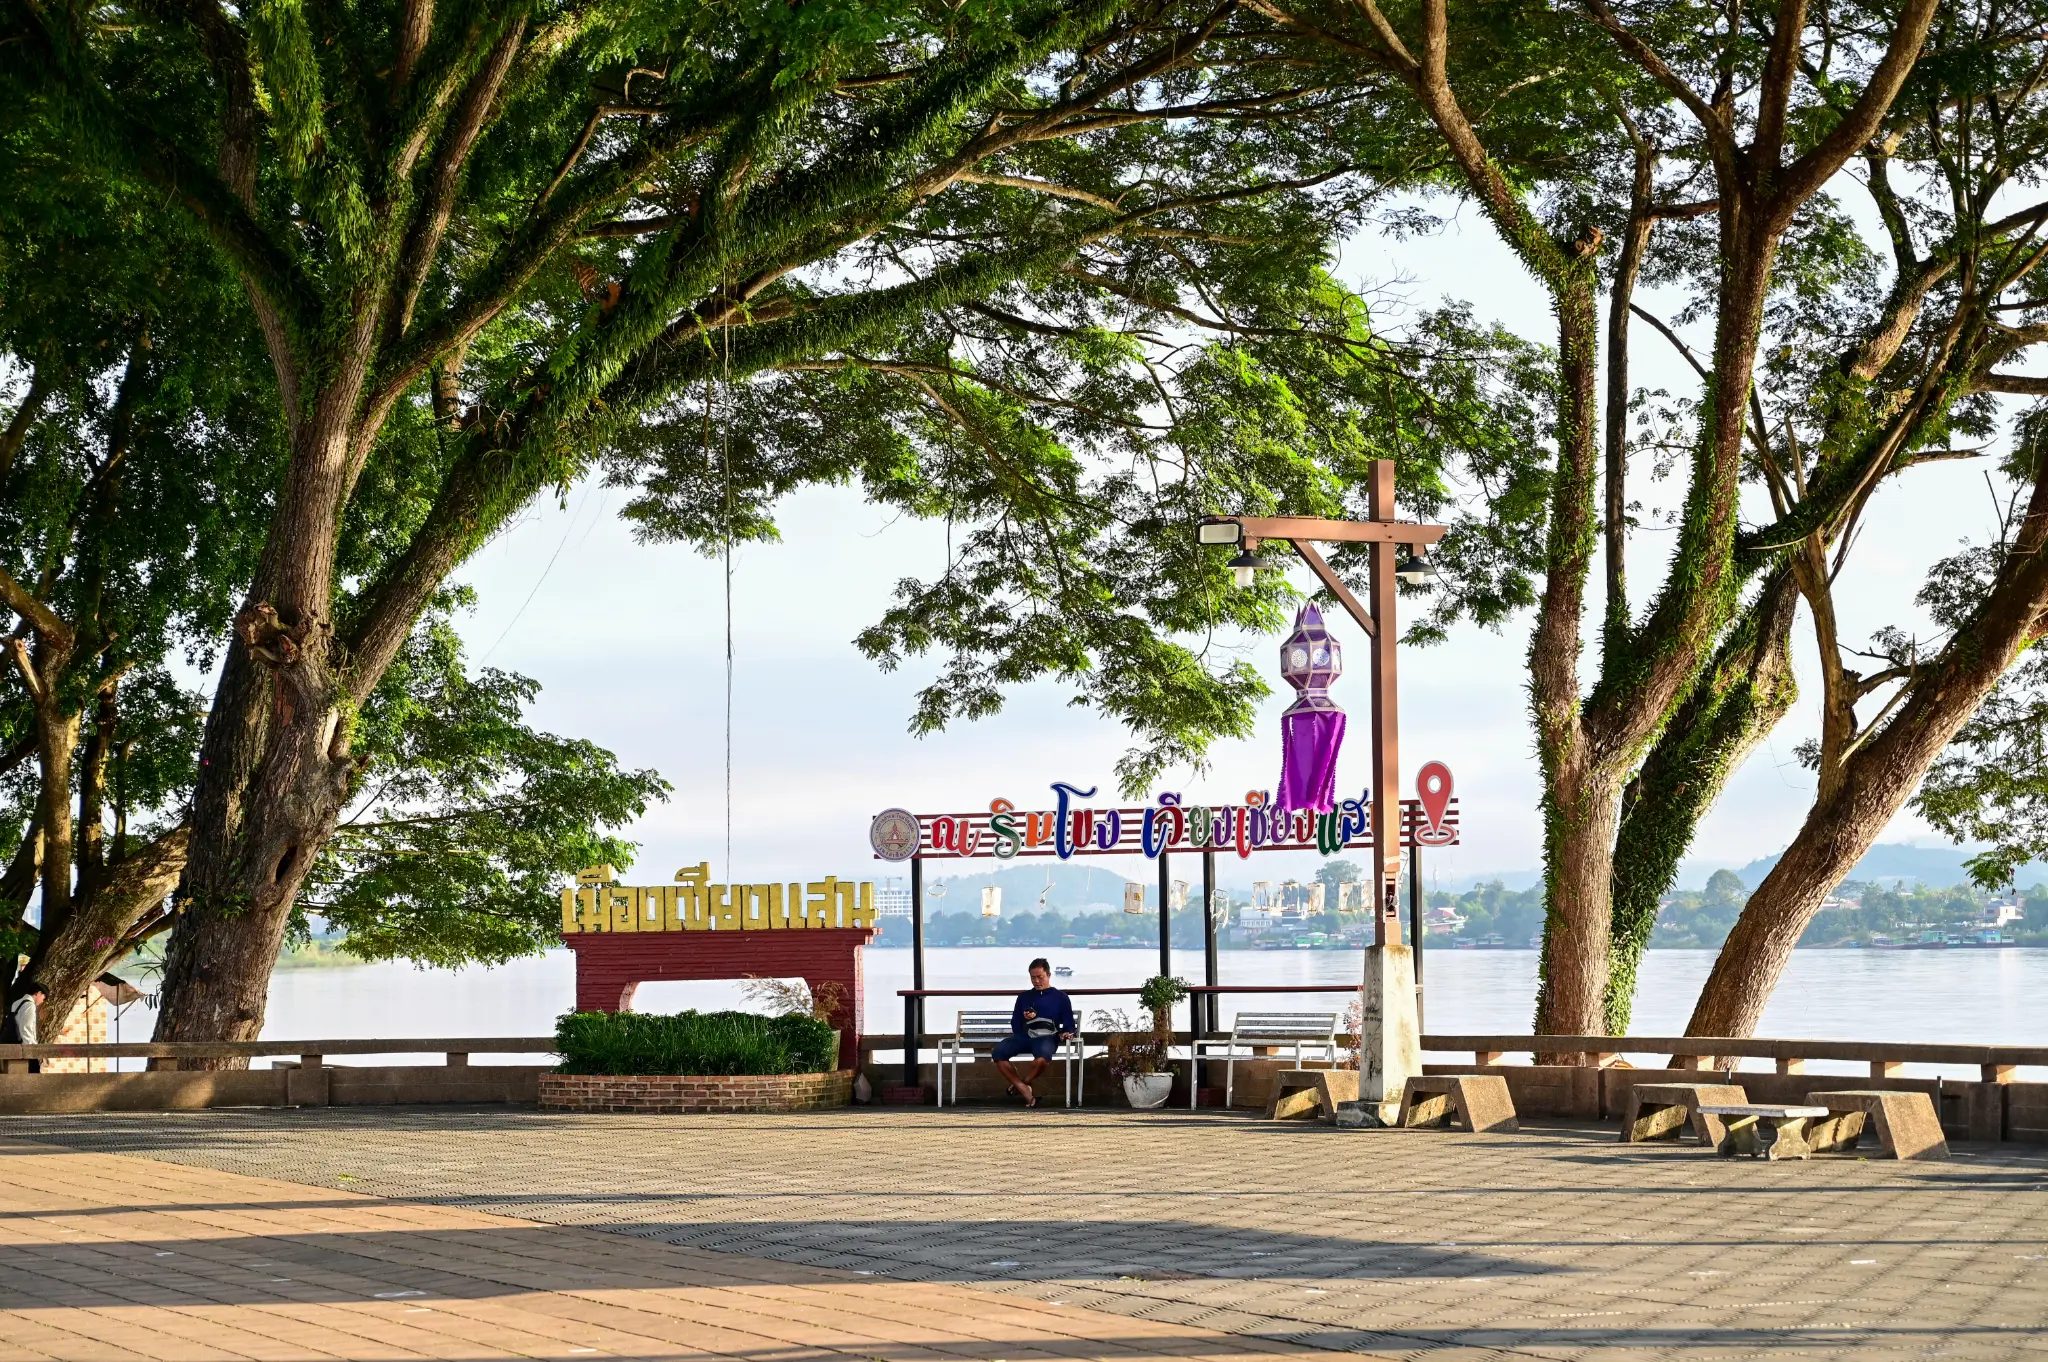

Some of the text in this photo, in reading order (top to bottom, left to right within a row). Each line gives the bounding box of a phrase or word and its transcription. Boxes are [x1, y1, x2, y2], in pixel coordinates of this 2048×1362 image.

[930, 781, 1404, 861] ณ ริมโขง เวียงเชียงแส
[562, 861, 880, 932] เมืองเชียงแสน
